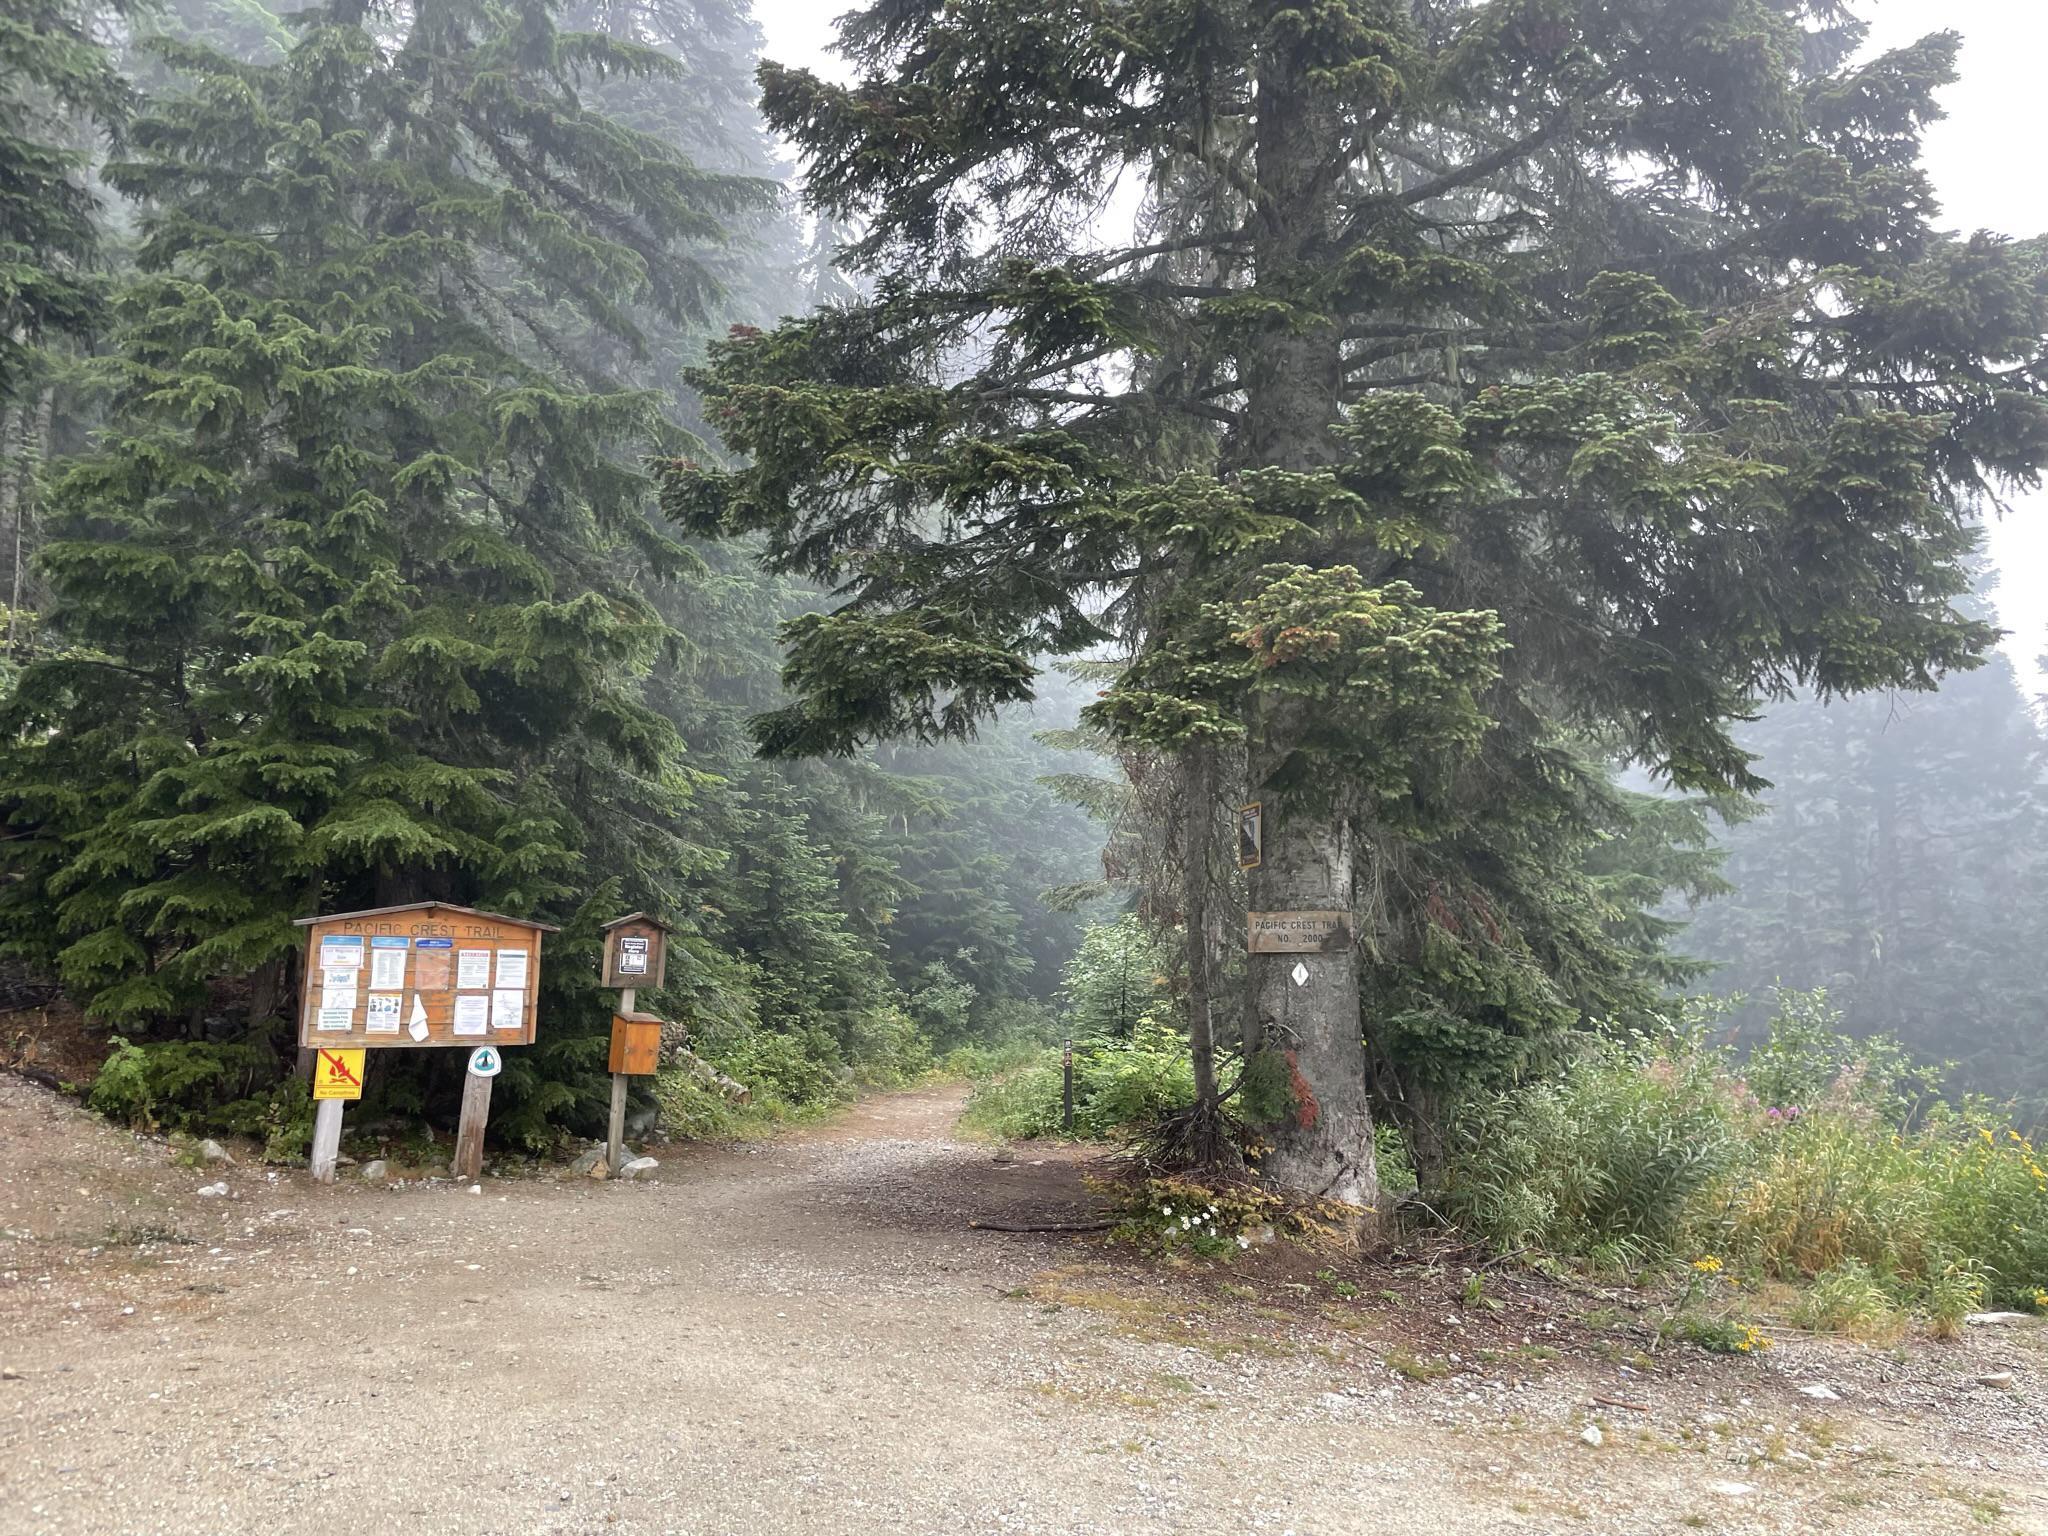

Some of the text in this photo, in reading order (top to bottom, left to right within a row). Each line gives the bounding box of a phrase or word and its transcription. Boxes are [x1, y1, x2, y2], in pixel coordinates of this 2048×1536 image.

[344, 922, 504, 938] PACIFIC CREST TRAIL
[1255, 921, 1287, 930] PACIFIC
[1290, 921, 1316, 930] CREST
[1303, 934, 1323, 943] 2000
